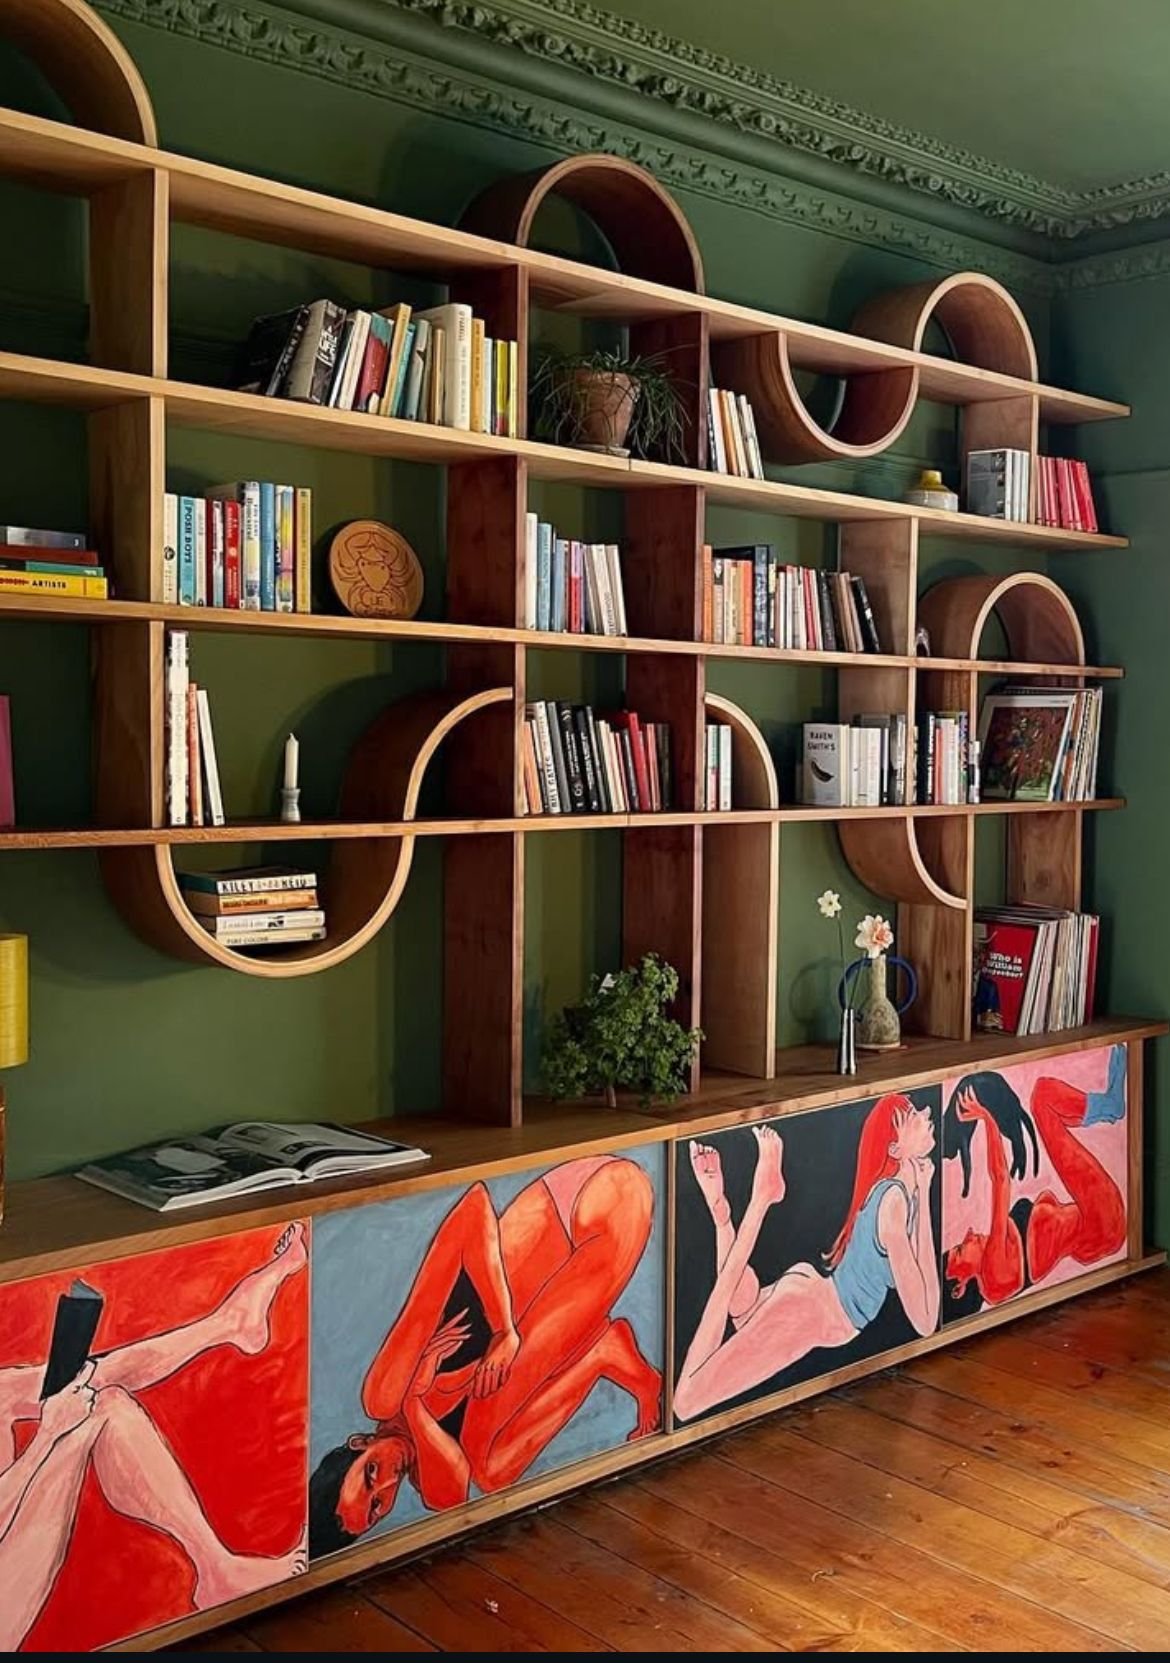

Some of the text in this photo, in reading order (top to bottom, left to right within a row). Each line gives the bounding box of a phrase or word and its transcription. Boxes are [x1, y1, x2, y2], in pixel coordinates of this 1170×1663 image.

[184, 506, 193, 564] POSH BOYS
[32, 580, 66, 589] ARTISTS
[810, 731, 833, 740] RAVEN
[990, 952, 1011, 963] Who
